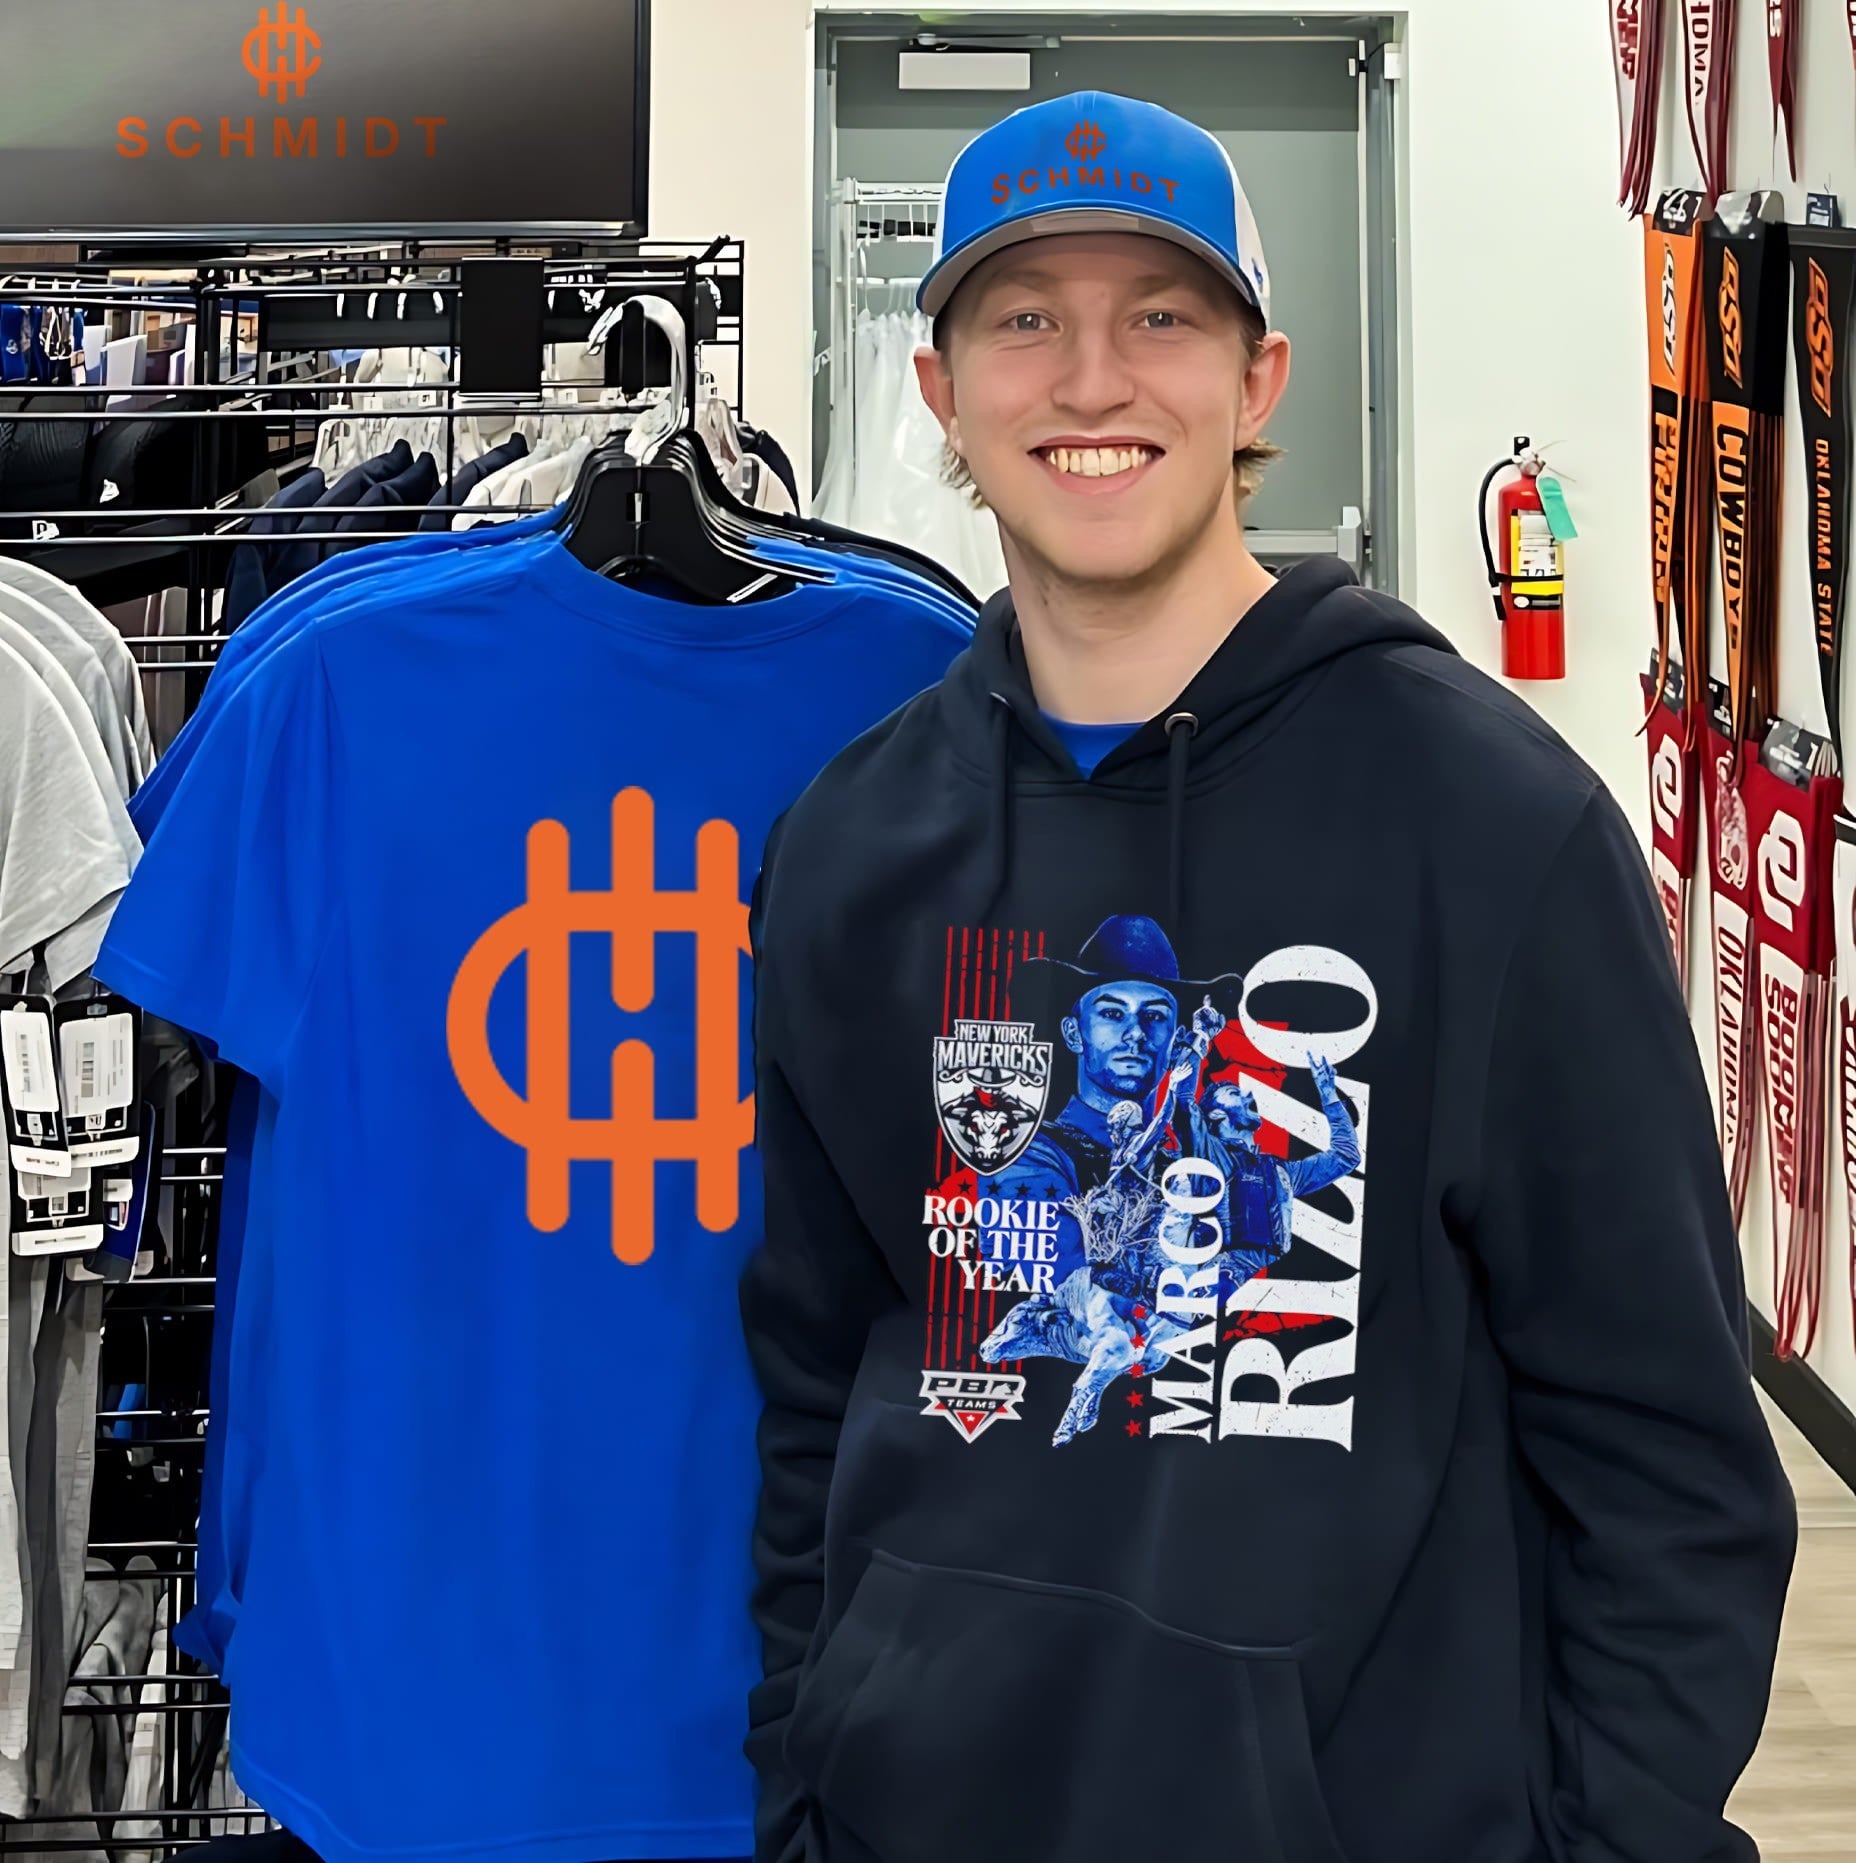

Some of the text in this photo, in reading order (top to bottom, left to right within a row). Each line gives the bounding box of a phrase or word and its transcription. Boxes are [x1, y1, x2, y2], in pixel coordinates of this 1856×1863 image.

[116, 117, 447, 158] SCHMIDT
[992, 167, 1179, 204] SCHMIDT
[1815, 438, 1832, 656] OKLAHOMA STATE
[960, 1024, 1028, 1043] NEW YORK
[1718, 928, 1743, 1143] OKLAHOMA
[938, 1040, 1048, 1076] MAVERICKS
[922, 1195, 1060, 1231] ROOKIE
[1217, 944, 1379, 1453] RIZZO
[928, 1226, 1059, 1262] OF THE
[958, 1259, 1056, 1294] YEAR
[1149, 1157, 1226, 1444] MARCO
[927, 1377, 1020, 1395] PBR
[947, 1399, 996, 1409] TEAMS
